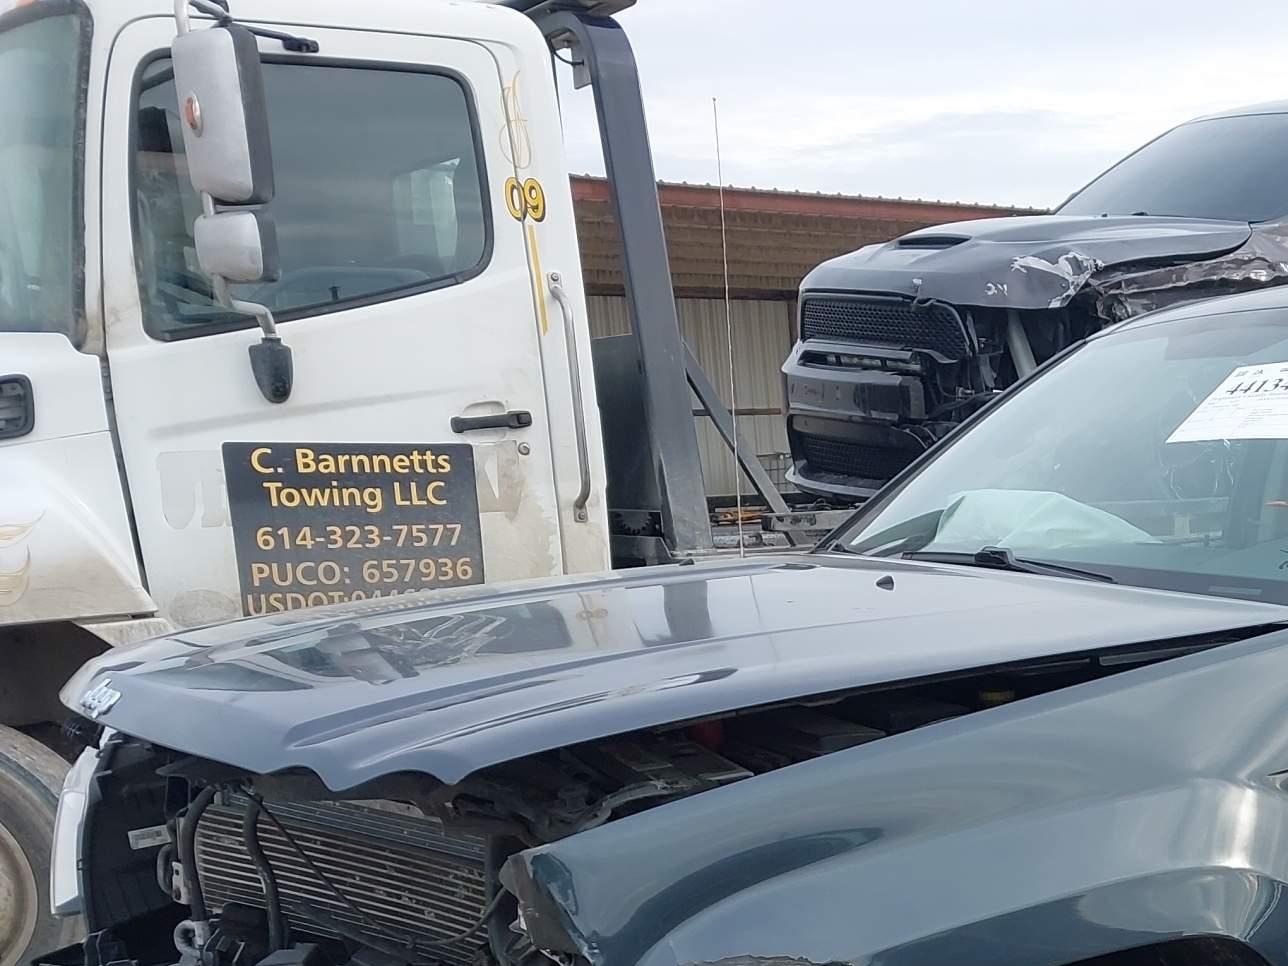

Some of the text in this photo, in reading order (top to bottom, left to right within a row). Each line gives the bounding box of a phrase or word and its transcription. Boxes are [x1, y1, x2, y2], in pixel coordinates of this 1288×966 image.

[504, 176, 546, 223] 09
[250, 447, 451, 474] C. Barnnetts
[262, 480, 448, 513] Towing LLC
[256, 523, 462, 551] 614-323-7577
[251, 557, 474, 587] PUCO: 657936
